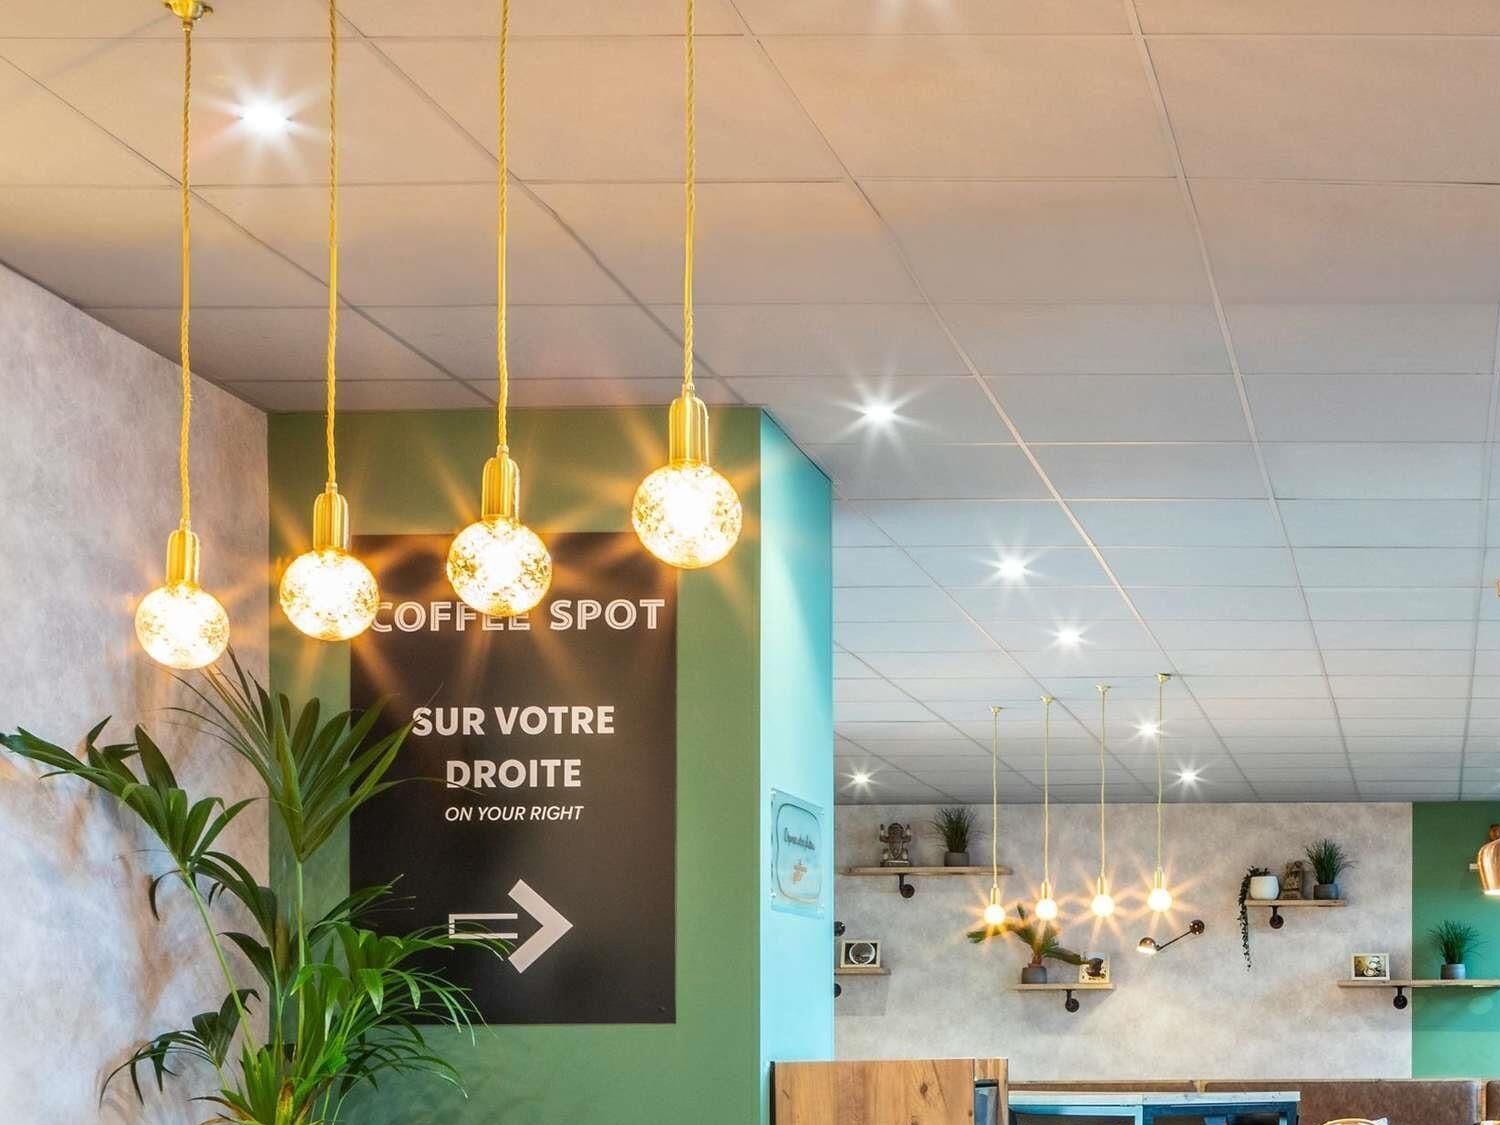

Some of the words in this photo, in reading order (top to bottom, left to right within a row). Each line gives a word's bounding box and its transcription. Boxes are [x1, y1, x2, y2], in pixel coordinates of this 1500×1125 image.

[550, 598, 665, 631] SPOT
[411, 707, 485, 736] SUR
[494, 705, 615, 735] VOTRE
[446, 758, 581, 788] DROITE
[445, 806, 474, 821] ON
[477, 806, 526, 821] YOUR
[529, 805, 585, 821] RIGHT
